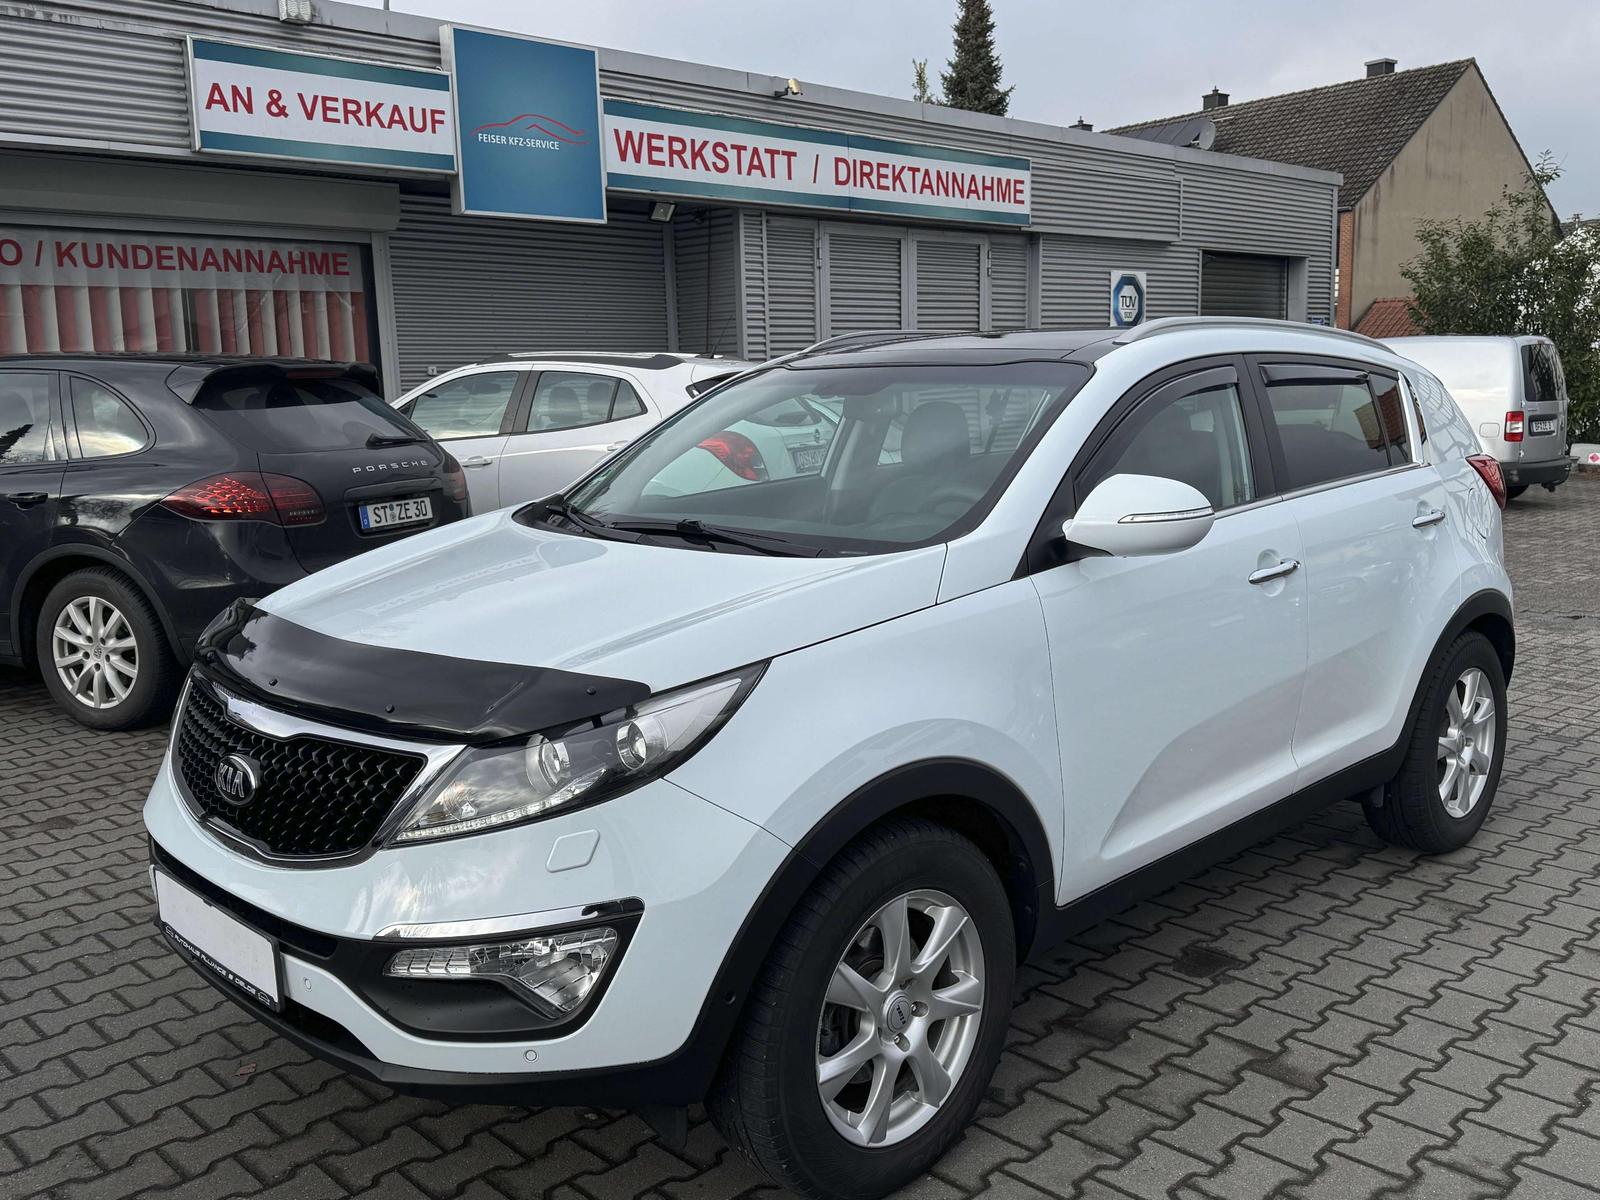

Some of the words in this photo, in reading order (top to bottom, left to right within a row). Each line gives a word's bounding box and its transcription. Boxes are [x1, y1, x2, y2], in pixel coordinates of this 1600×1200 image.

[205, 82, 254, 114] AN
[265, 89, 289, 118] &
[297, 92, 446, 134] VERKAUF
[478, 133, 507, 145] FEISER
[508, 136, 560, 150] KFZ-SERVICE
[613, 128, 798, 181] WERKSTATT
[812, 154, 820, 183] /
[834, 156, 1025, 205] DIREKTANNAHME
[35, 240, 43, 267] /
[55, 240, 351, 276] KUNDENANNAHME
[352, 460, 429, 473] PORSCHE
[373, 506, 389, 524] ST
[396, 502, 413, 521] ZE
[414, 500, 428, 518] 30
[217, 762, 245, 798] KIA
